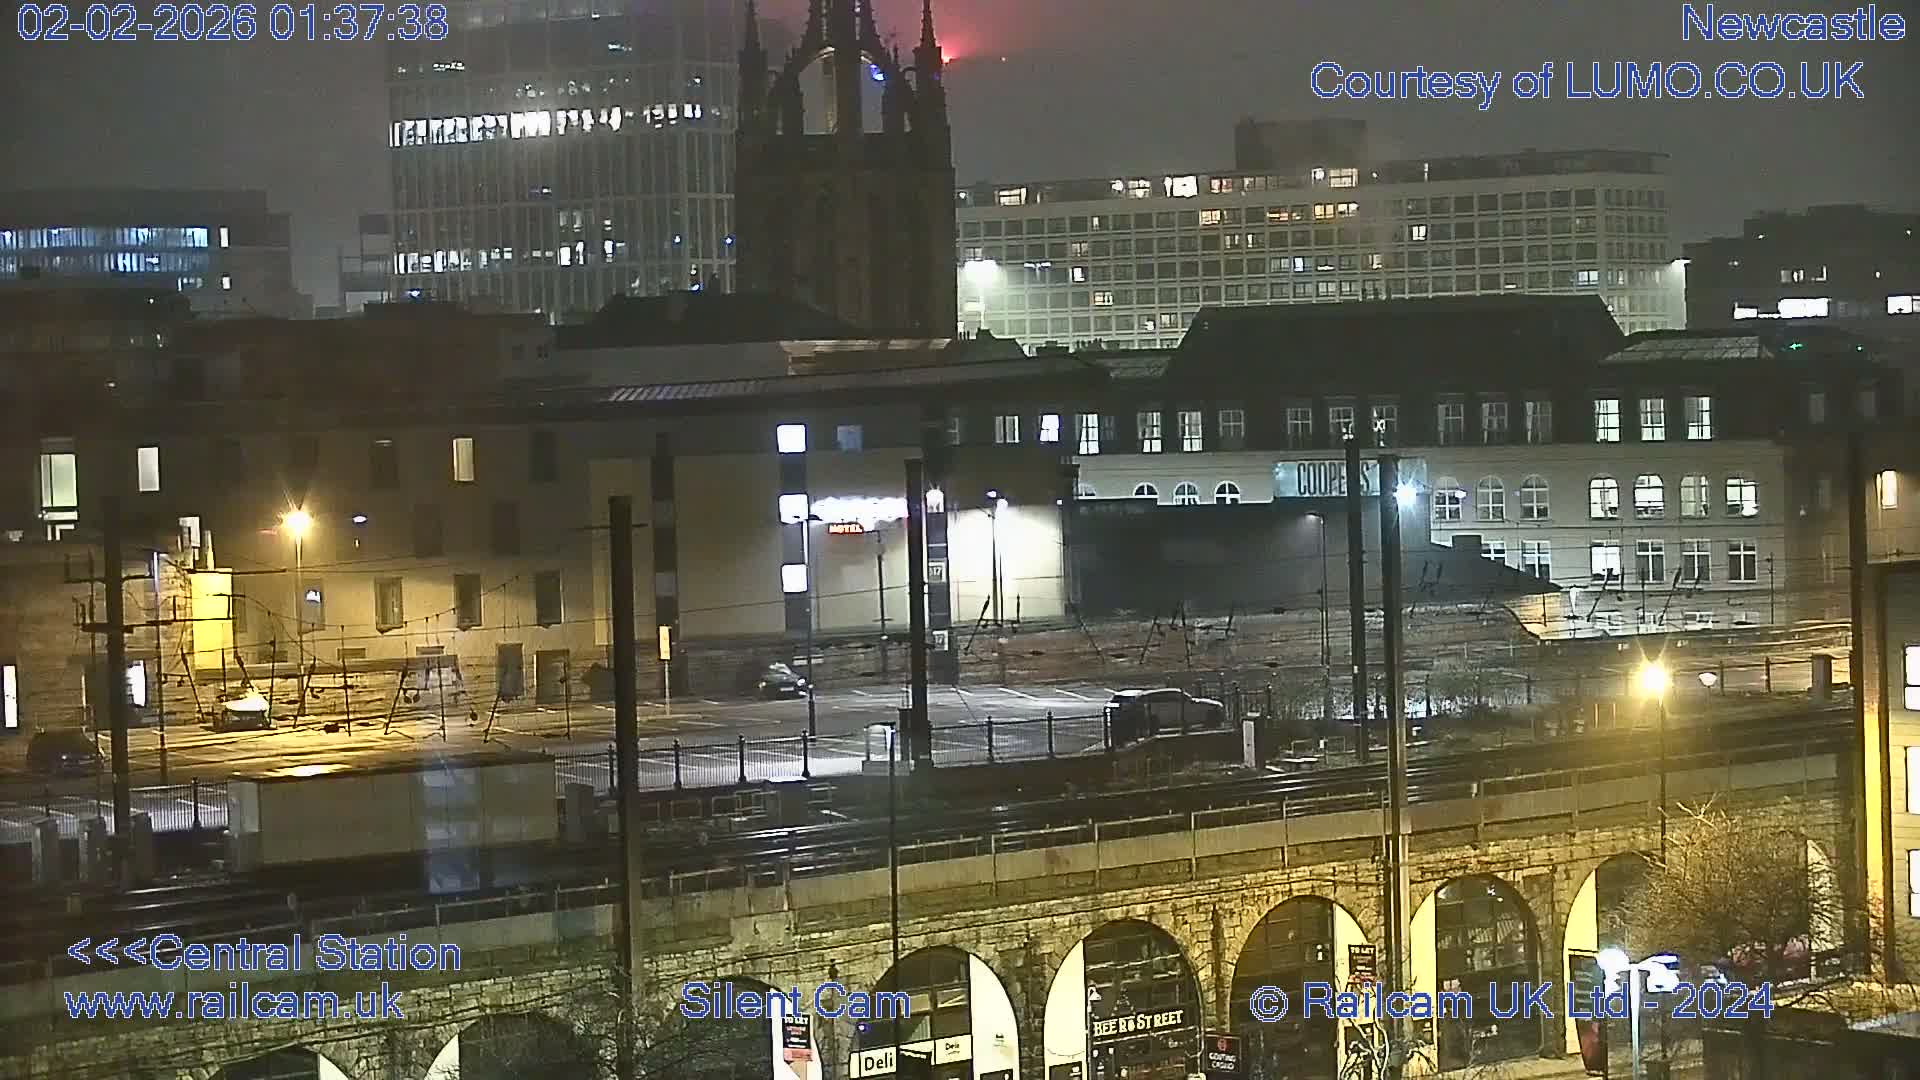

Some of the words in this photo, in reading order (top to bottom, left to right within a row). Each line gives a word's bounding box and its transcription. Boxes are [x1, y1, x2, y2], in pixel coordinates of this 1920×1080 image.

[1297, 461, 1370, 496] COOPES
[1137, 1009, 1184, 1030] STREET
[864, 1052, 894, 1071] Deli
